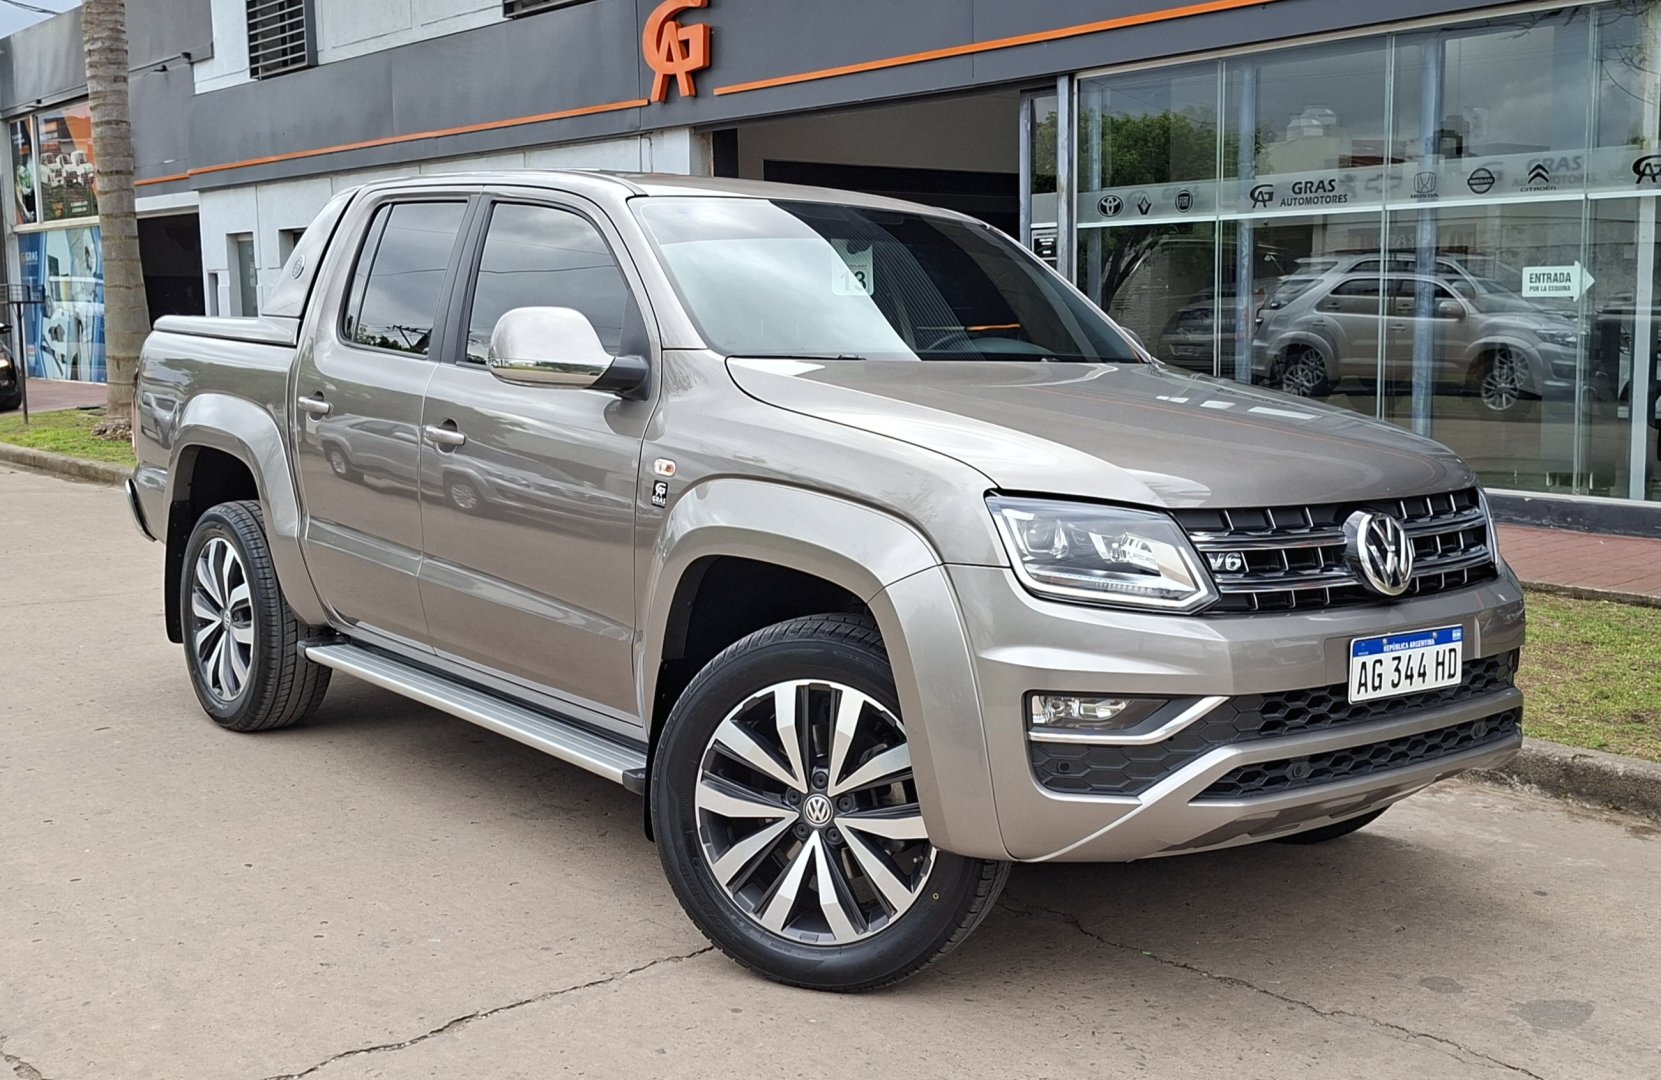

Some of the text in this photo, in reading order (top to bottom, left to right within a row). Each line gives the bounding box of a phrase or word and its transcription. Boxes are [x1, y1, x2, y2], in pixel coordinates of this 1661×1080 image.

[1292, 179, 1336, 195] GRAS
[1280, 194, 1348, 207] AUTOMOTORES
[840, 270, 867, 291] 13
[1529, 272, 1571, 284] ENTRADA
[1548, 285, 1571, 293] ESQUINA
[1208, 552, 1242, 571] V6
[1409, 638, 1435, 649] ARGENTINA
[1357, 647, 1457, 695] AG 344 HD
